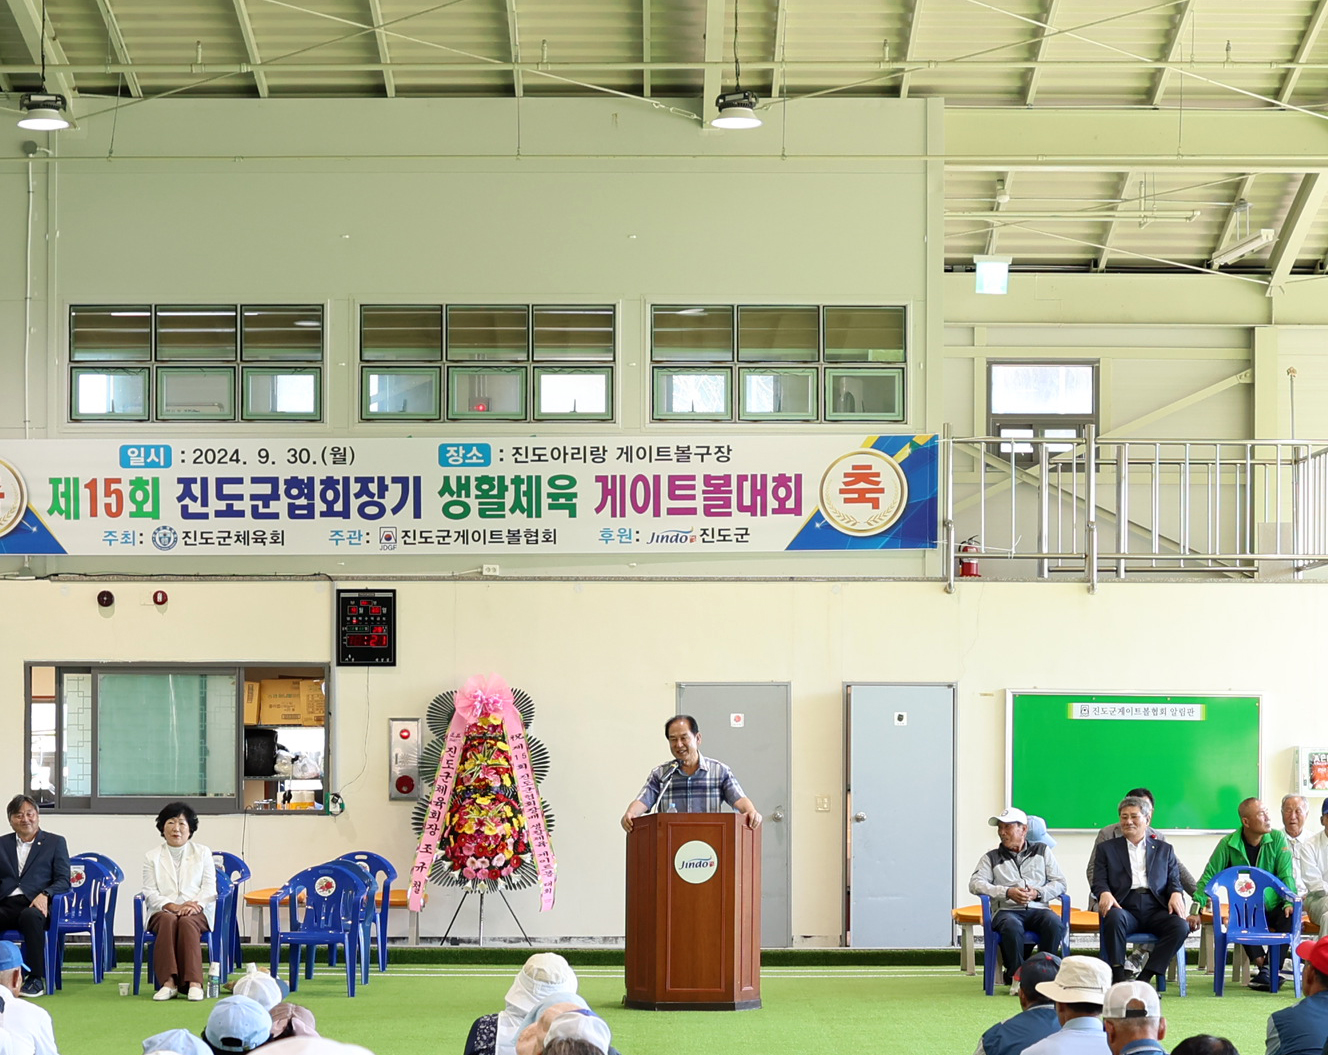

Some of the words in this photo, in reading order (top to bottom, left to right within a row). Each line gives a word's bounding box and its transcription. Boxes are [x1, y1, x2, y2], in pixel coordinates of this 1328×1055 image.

[126, 447, 166, 466] 일시
[192, 448, 247, 465] 2024.
[257, 448, 276, 465] 9.
[445, 446, 485, 465] 장소
[511, 445, 608, 464] 진도아리랑
[615, 444, 732, 463] 게이트볼구장
[838, 464, 885, 510] 축
[46, 476, 160, 520] 제15회
[175, 475, 422, 521] 진도군협회장기
[437, 474, 578, 520] 생활체육
[593, 473, 803, 518] 게이트볼대회
[181, 530, 285, 546] 진도군체육회
[400, 528, 557, 546] 진도군게이트볼협회
[698, 527, 751, 544] 진도군
[1092, 706, 1167, 717] 진도군게이트볼협회
[1169, 706, 1195, 717] 알림판
